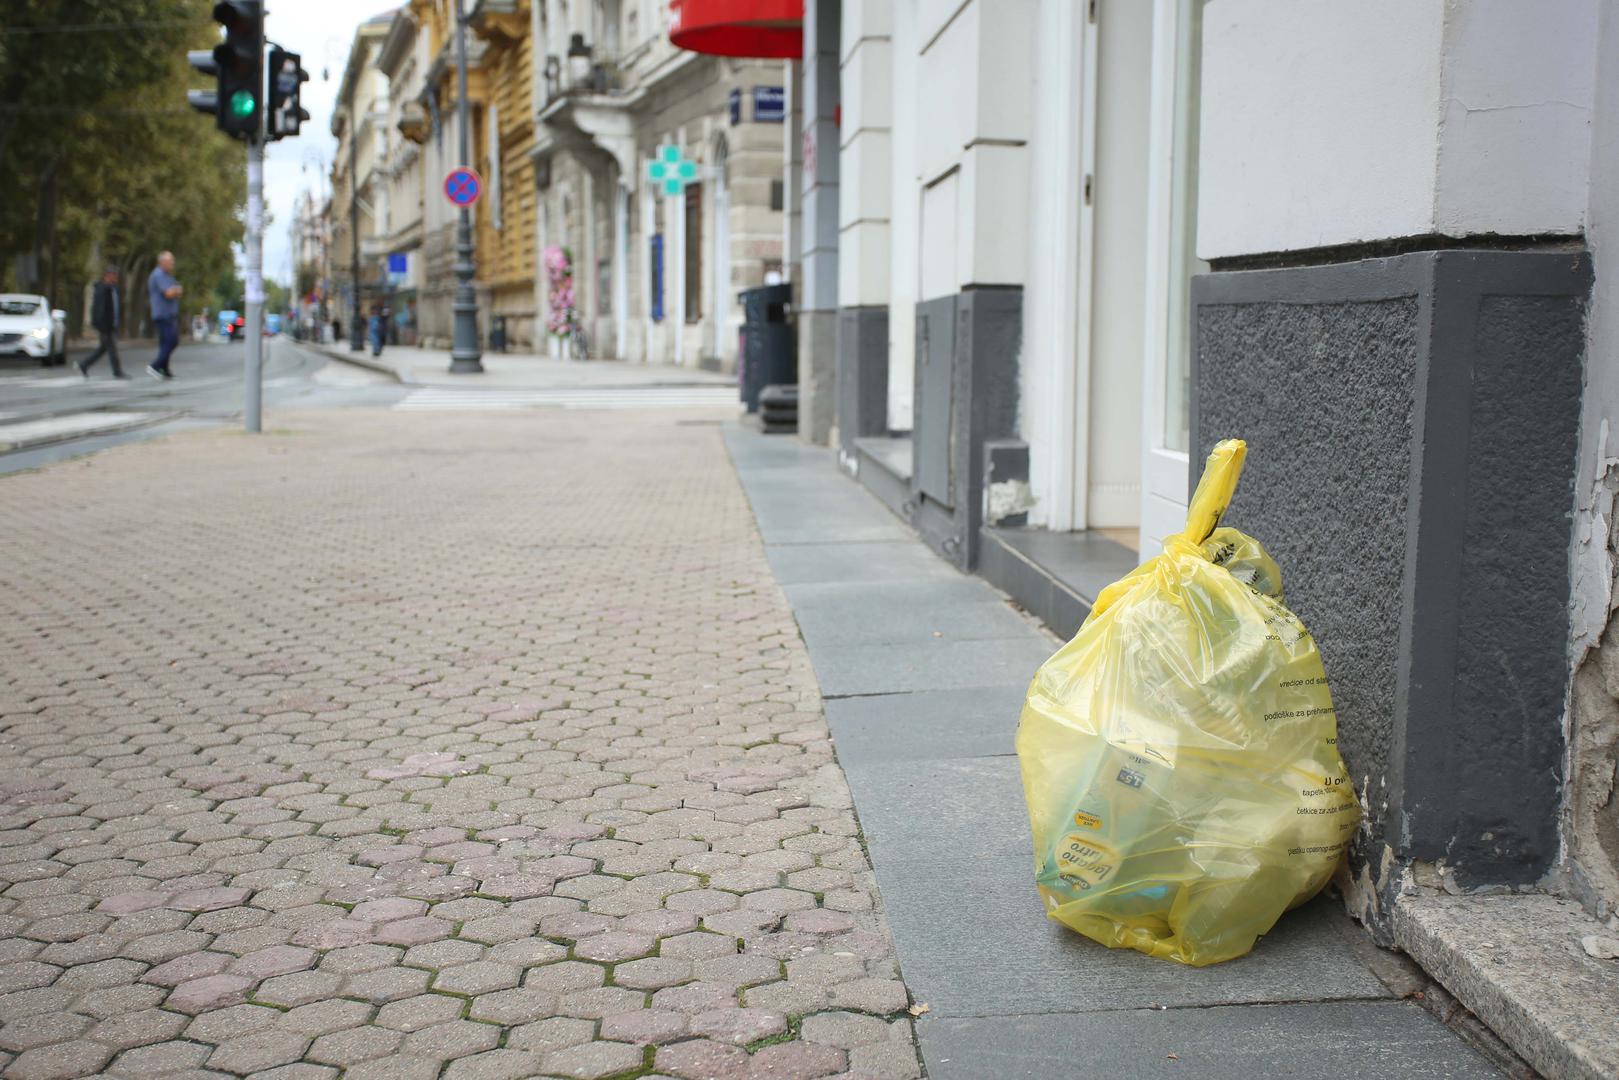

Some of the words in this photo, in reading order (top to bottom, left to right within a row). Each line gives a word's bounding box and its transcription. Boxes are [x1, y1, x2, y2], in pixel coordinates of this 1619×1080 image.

[1305, 677, 1315, 685] od
[1306, 706, 1336, 717] prehram
[1325, 777, 1332, 786] U
